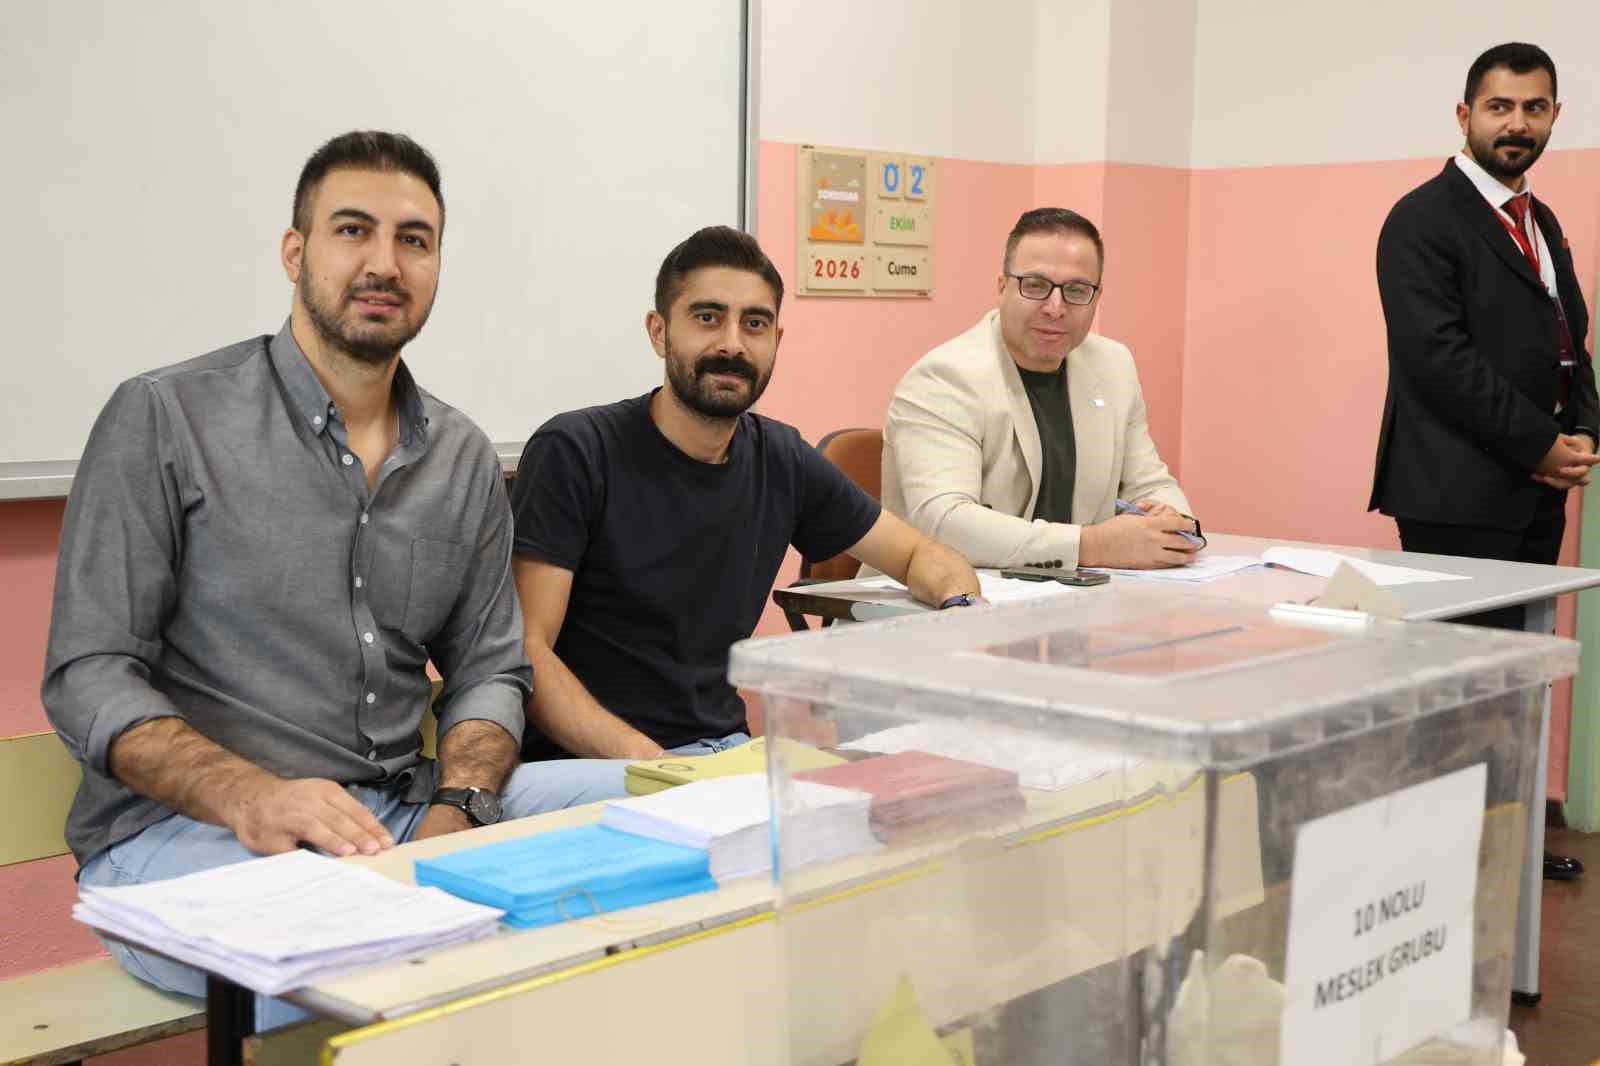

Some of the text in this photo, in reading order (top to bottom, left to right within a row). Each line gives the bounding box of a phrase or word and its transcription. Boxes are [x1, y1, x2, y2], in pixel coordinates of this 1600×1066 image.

[815, 259, 860, 279] 2026
[888, 261, 917, 276] Cuma
[1354, 880, 1425, 938] 10 NOLU
[1314, 924, 1448, 1010] MESLEK GRUBU
